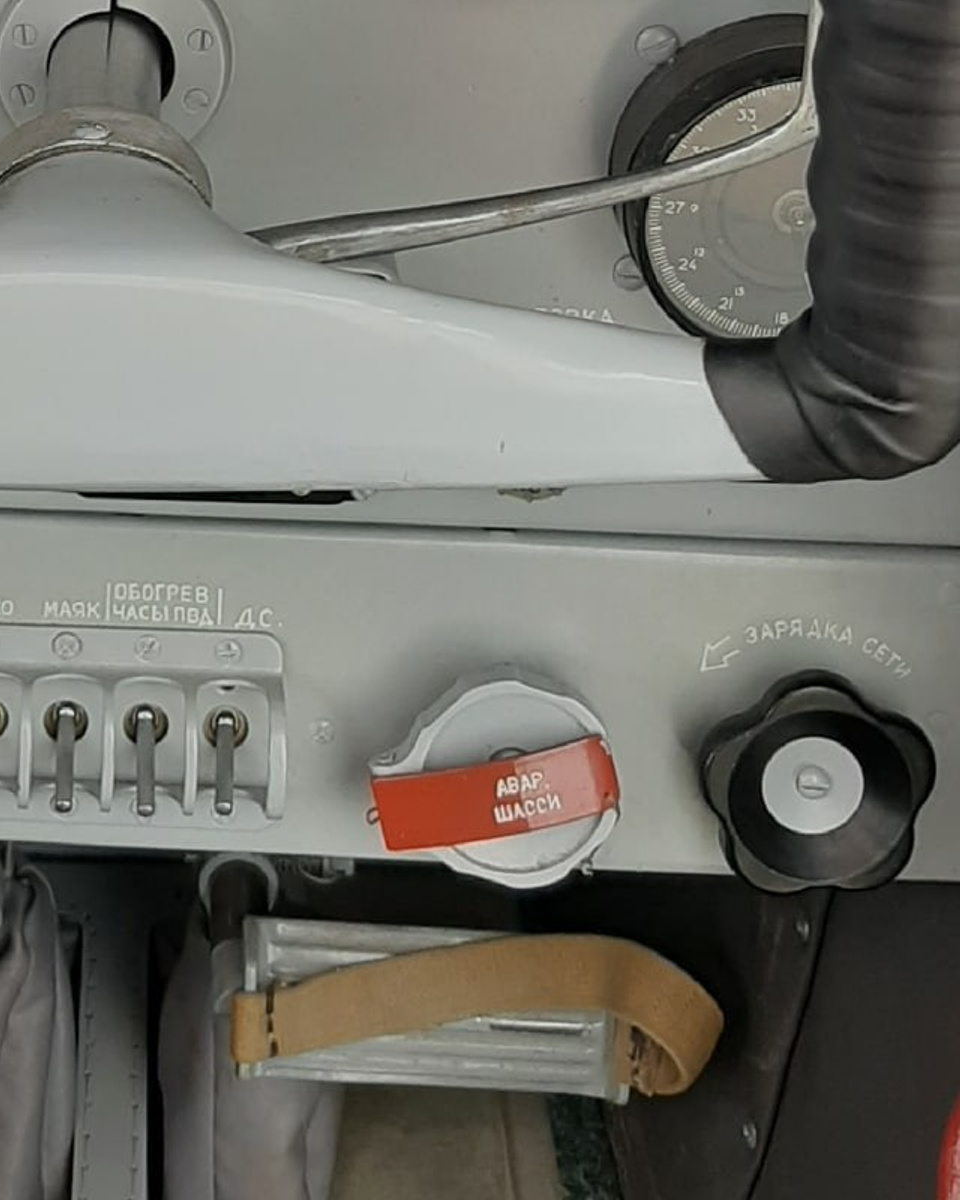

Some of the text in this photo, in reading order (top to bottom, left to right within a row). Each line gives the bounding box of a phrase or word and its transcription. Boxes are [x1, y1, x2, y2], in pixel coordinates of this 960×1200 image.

[665, 201, 685, 214] 27
[678, 258, 697, 271] 24
[718, 297, 734, 310] 21
[775, 312, 789, 325] 18
[114, 583, 209, 603] ОБОГРЕВ
[43, 600, 101, 620] МАЯК
[112, 603, 169, 621] ЧАСЫ
[174, 605, 214, 626] ПВД
[744, 618, 912, 679] ЗАРЯДКА СЕТИ
[493, 792, 561, 824] ШАССИ
